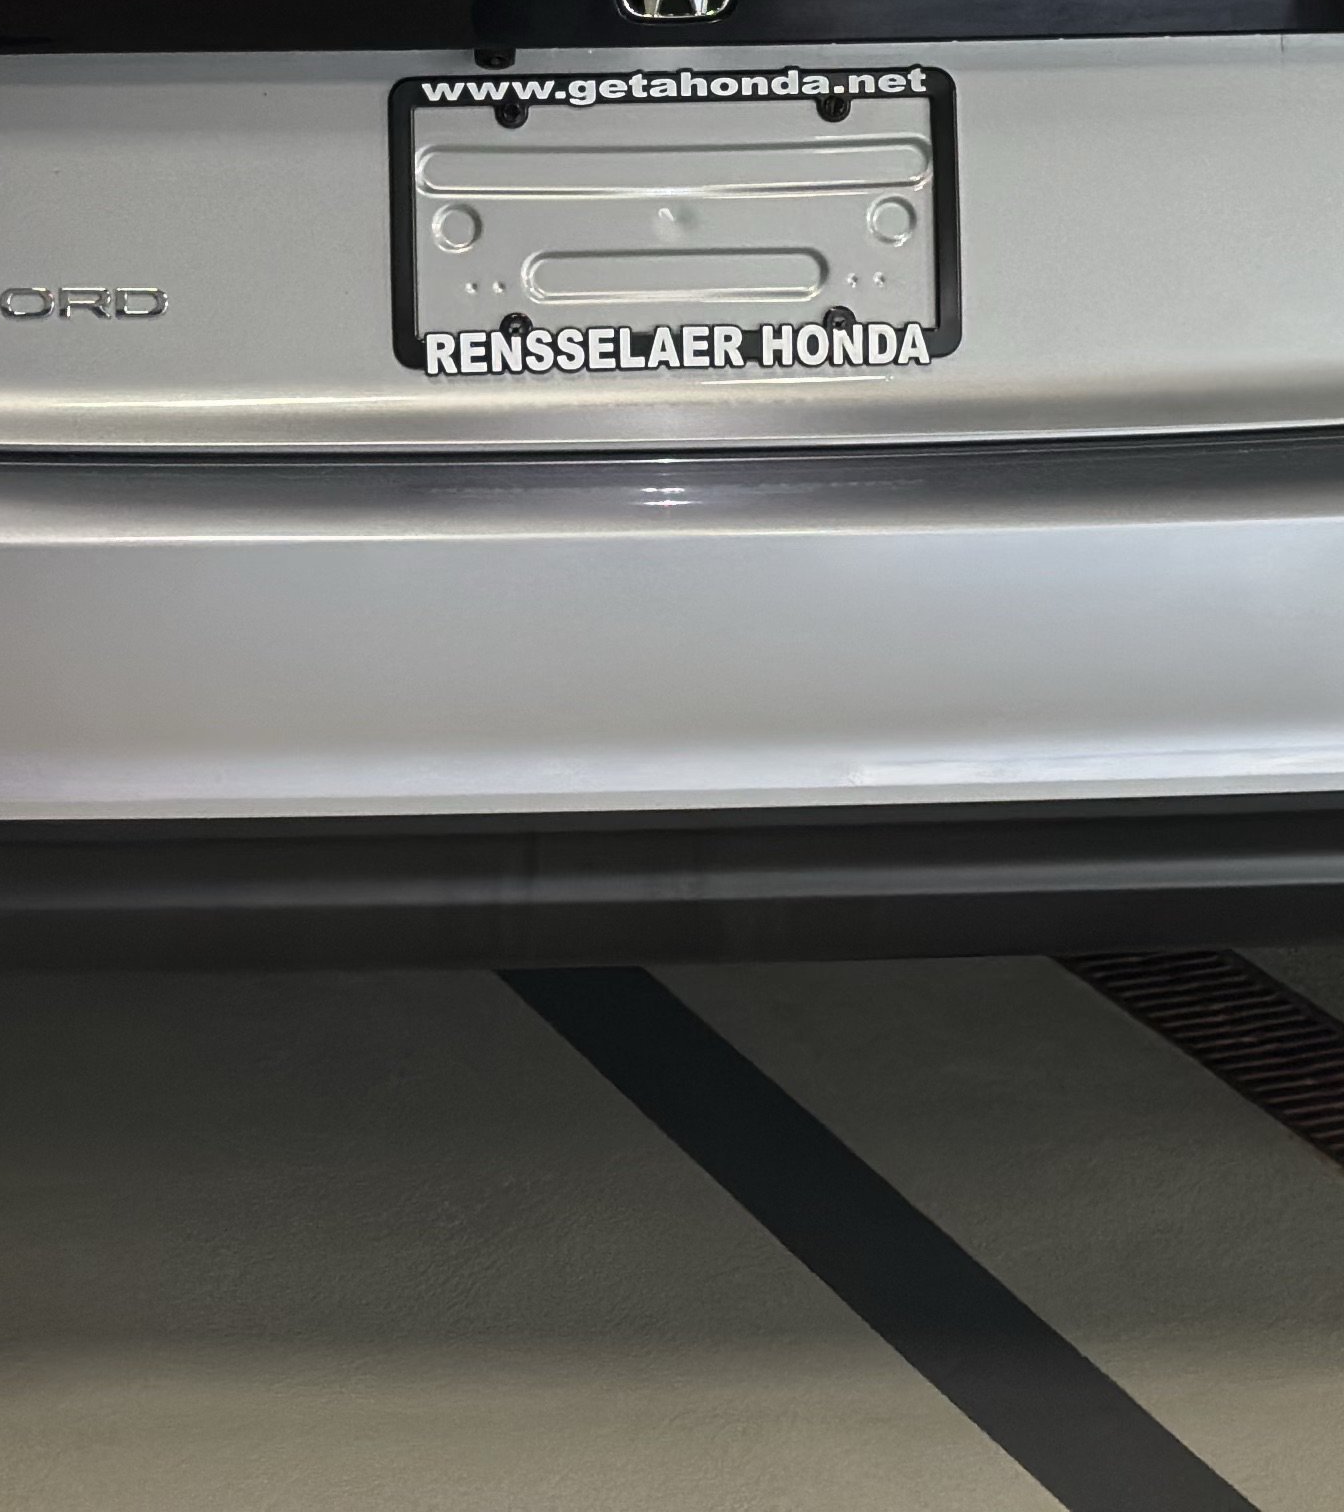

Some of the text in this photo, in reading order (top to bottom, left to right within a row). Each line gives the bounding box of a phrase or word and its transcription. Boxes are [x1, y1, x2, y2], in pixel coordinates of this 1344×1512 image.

[422, 67, 927, 105] www.getahonda.net
[425, 323, 931, 375] RENSSELAER HONDA
